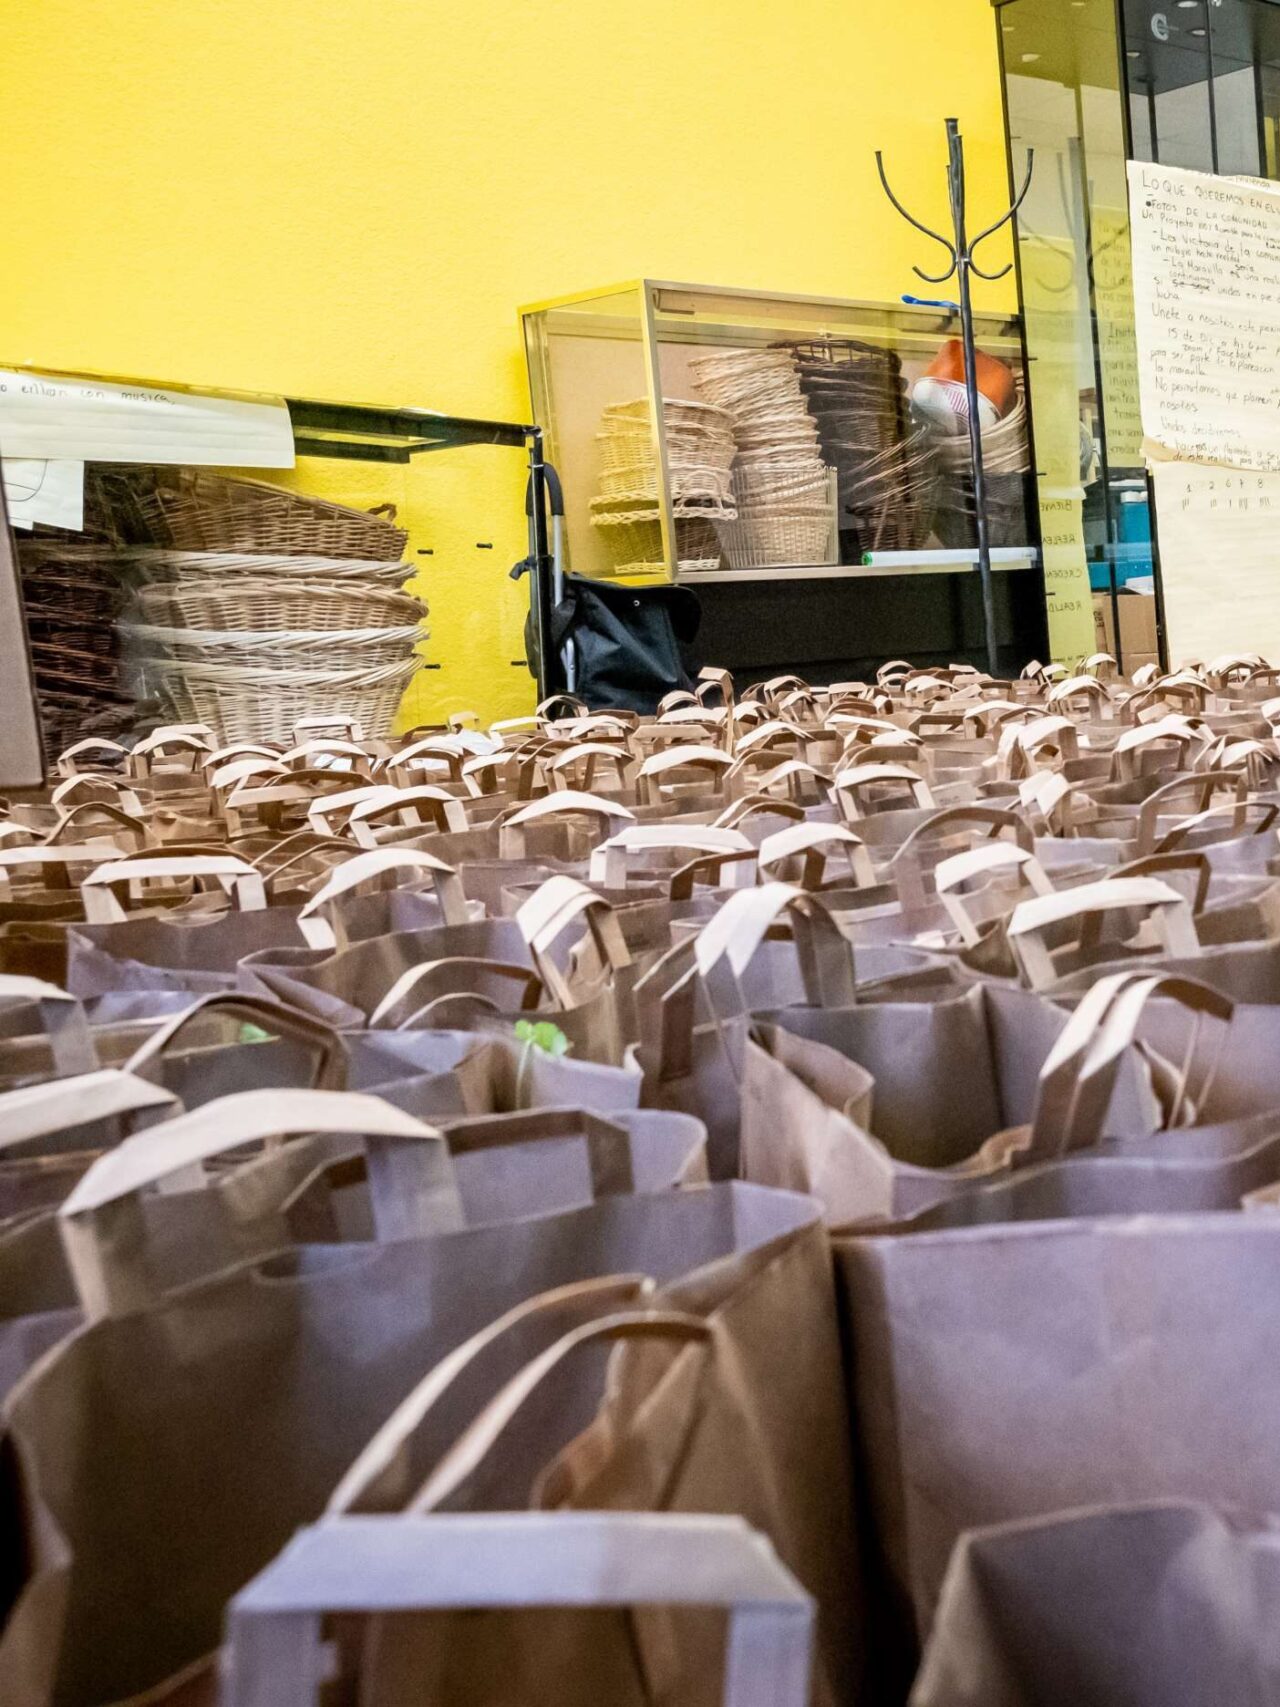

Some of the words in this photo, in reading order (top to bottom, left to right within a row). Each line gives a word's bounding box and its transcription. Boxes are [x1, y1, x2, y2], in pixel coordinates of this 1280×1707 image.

[1194, 185, 1244, 206] QUEREMOS
[1250, 198, 1262, 209] EN
[1151, 200, 1177, 213] FOTOS
[1186, 208, 1199, 217] DE
[1206, 211, 1218, 220] LA
[1221, 213, 1268, 230] COMUNIDAD
[1224, 240, 1234, 252] de
[1240, 241, 1251, 256] la
[1183, 329, 1194, 342] de
